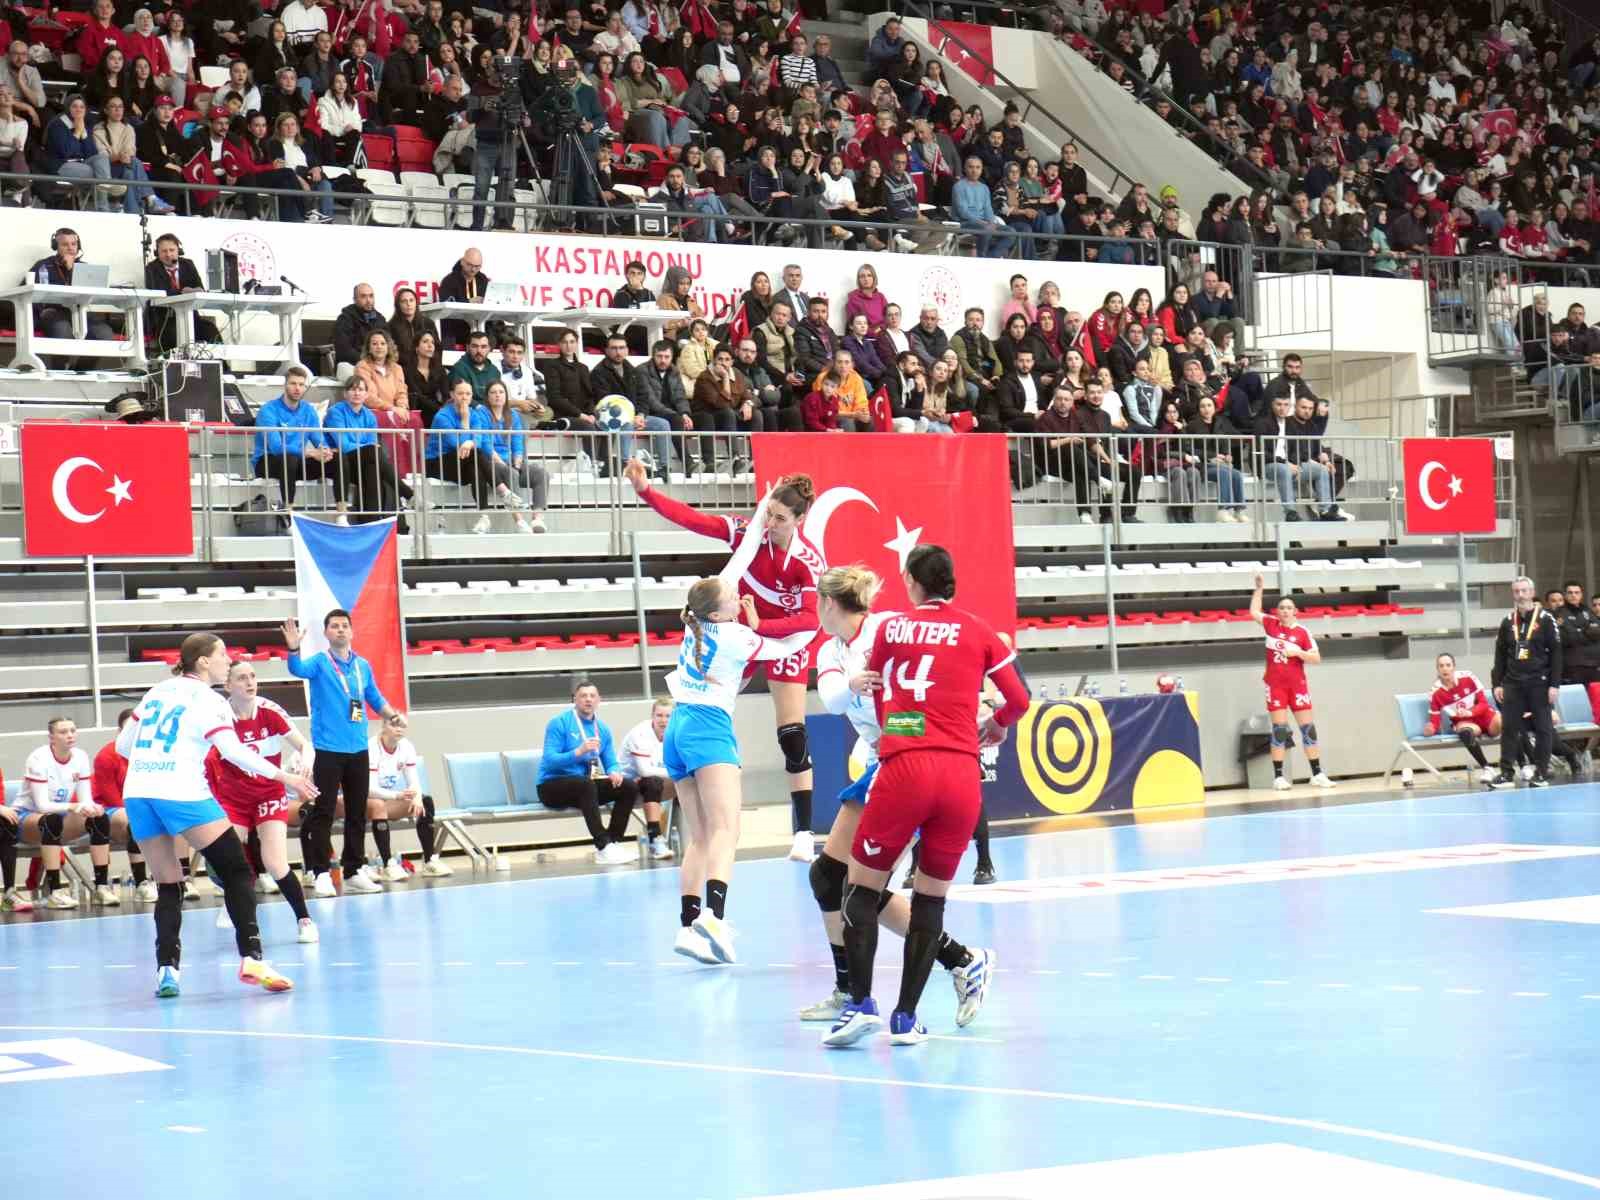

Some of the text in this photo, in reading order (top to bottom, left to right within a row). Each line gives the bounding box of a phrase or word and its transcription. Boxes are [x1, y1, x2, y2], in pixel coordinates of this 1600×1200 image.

[885, 616, 961, 646] GÖKTEPE
[882, 654, 936, 702] 14
[136, 700, 187, 753] 24
